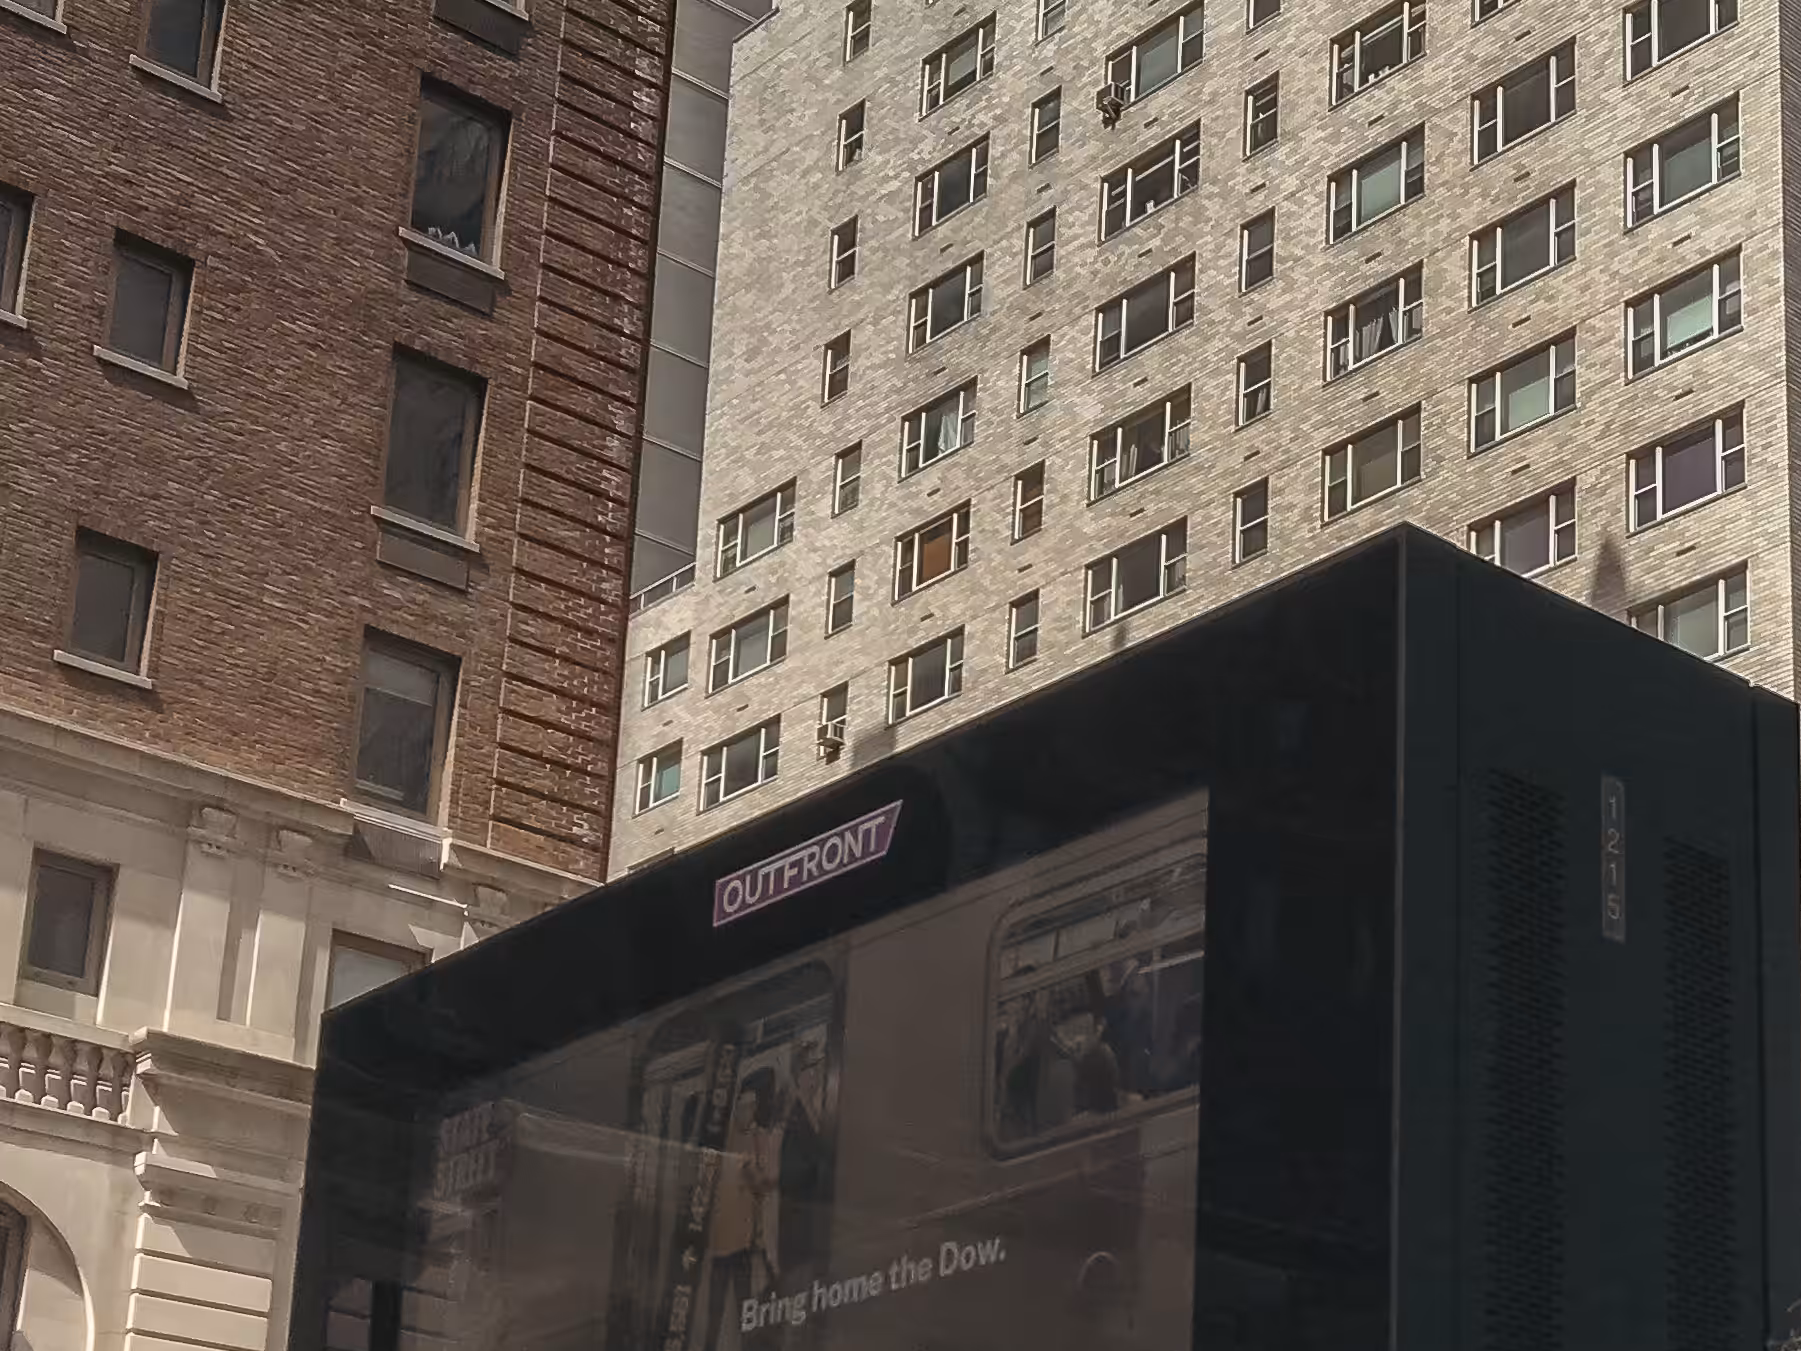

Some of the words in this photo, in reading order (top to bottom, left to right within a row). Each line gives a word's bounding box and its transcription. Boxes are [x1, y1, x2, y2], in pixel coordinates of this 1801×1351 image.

[722, 816, 887, 913] OUTFRONT
[739, 1290, 808, 1333] Bring
[812, 1270, 883, 1312] home
[888, 1251, 934, 1291] the
[938, 1236, 1007, 1278] Dow.
